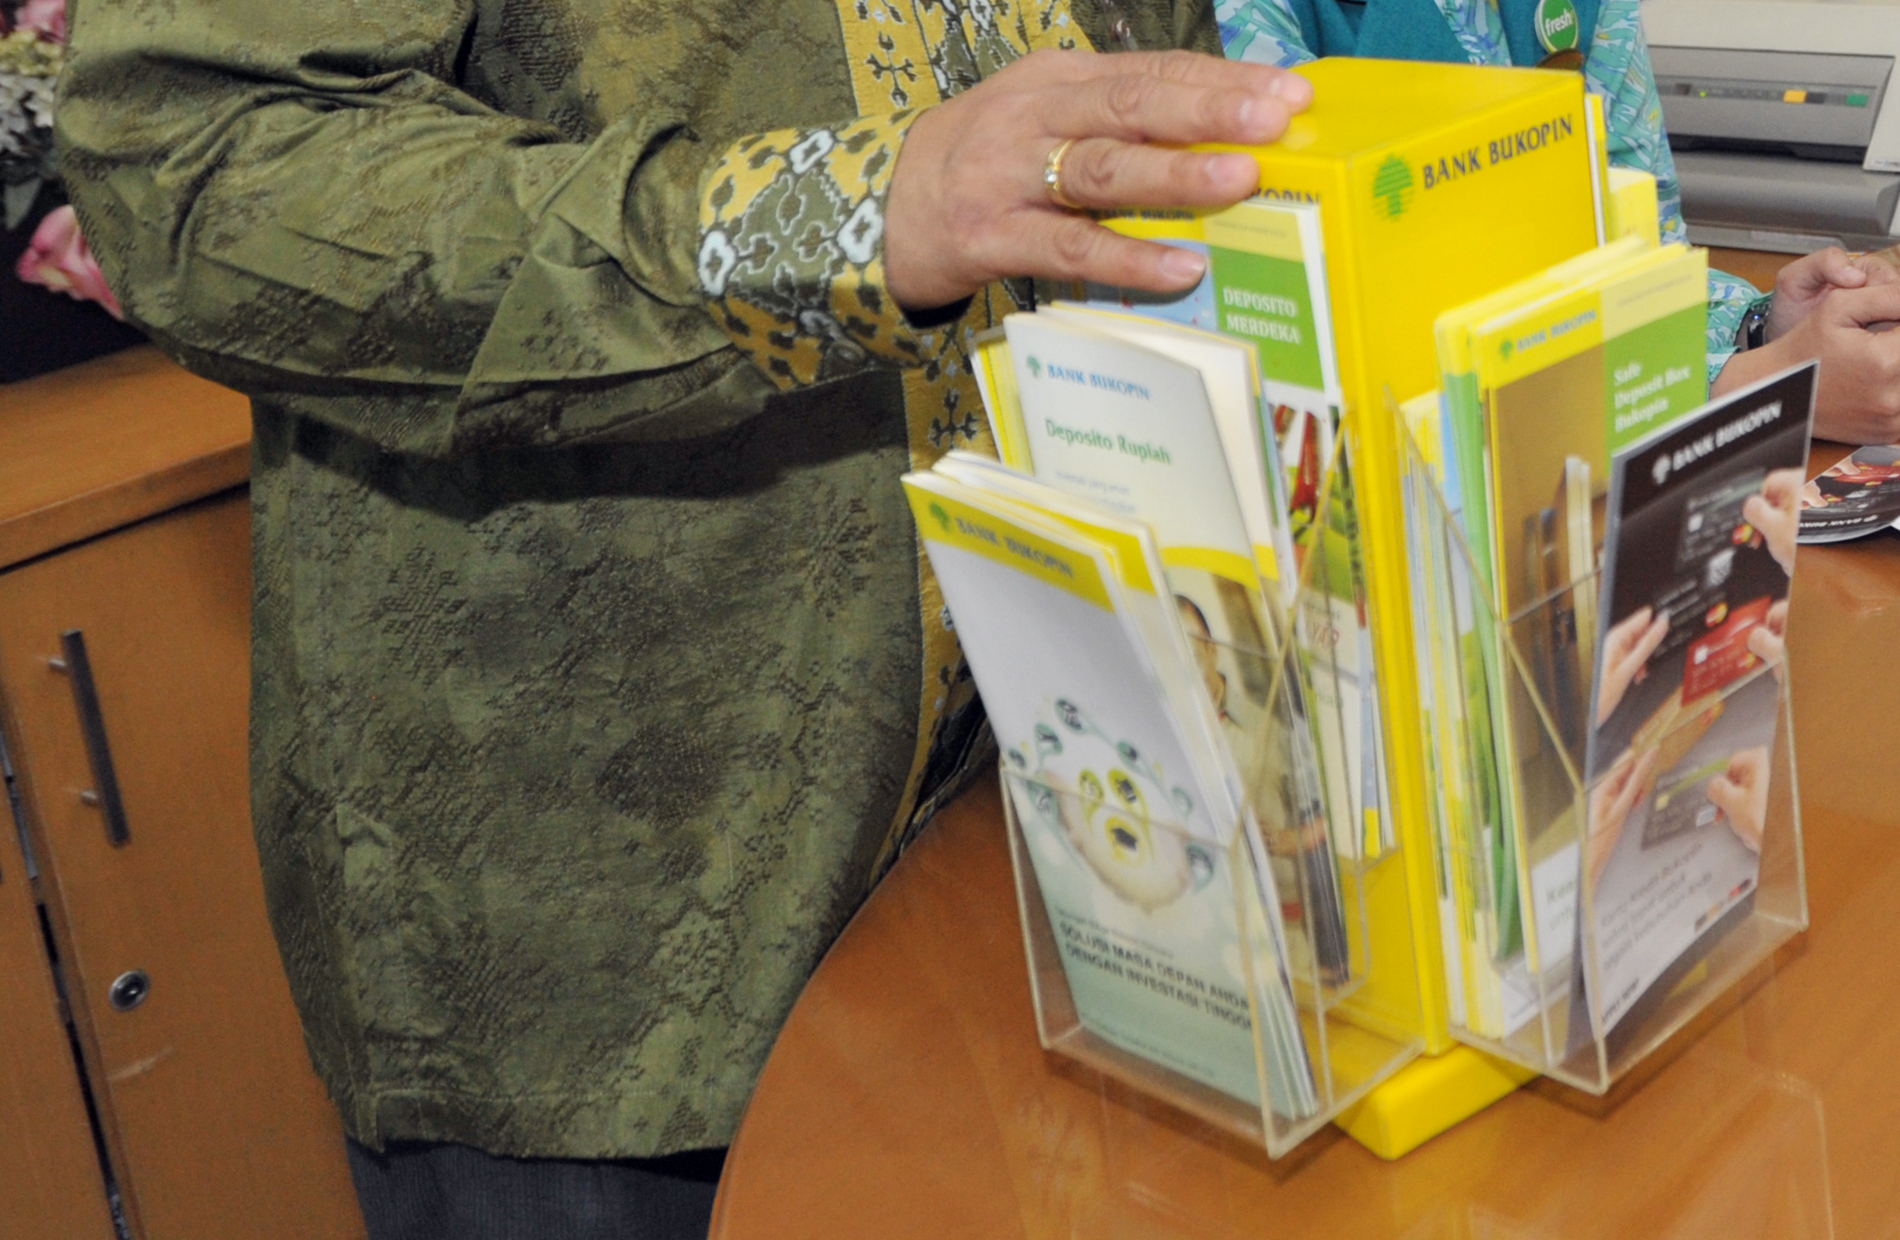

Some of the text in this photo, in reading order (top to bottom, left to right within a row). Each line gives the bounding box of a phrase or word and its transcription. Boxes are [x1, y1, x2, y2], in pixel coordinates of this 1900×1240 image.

[1545, 7, 1573, 37] fresh
[1422, 112, 1574, 190] BANK BUKOPIN
[1222, 287, 1298, 319] DEPOSITO
[1226, 313, 1301, 345] MERDEKA
[1516, 329, 1548, 353] BANK
[1046, 363, 1151, 401] BANK BUKOPIN
[1613, 361, 1643, 387] Safe
[1614, 375, 1665, 410] Deposit
[1614, 397, 1669, 434] Bukopin
[1045, 418, 1172, 465] Deposito Rupiah
[1672, 399, 1783, 471] BANK BUKOPIN
[956, 515, 1075, 580] BANK BUKOPIN
[1058, 920, 1109, 953] SOLUSI
[1111, 944, 1152, 971] MASA
[1156, 961, 1205, 993] DEPAN
[1208, 983, 1250, 1011] ANDA
[1065, 942, 1123, 977] DENGAN
[1126, 966, 1199, 1010] INVESTASI
